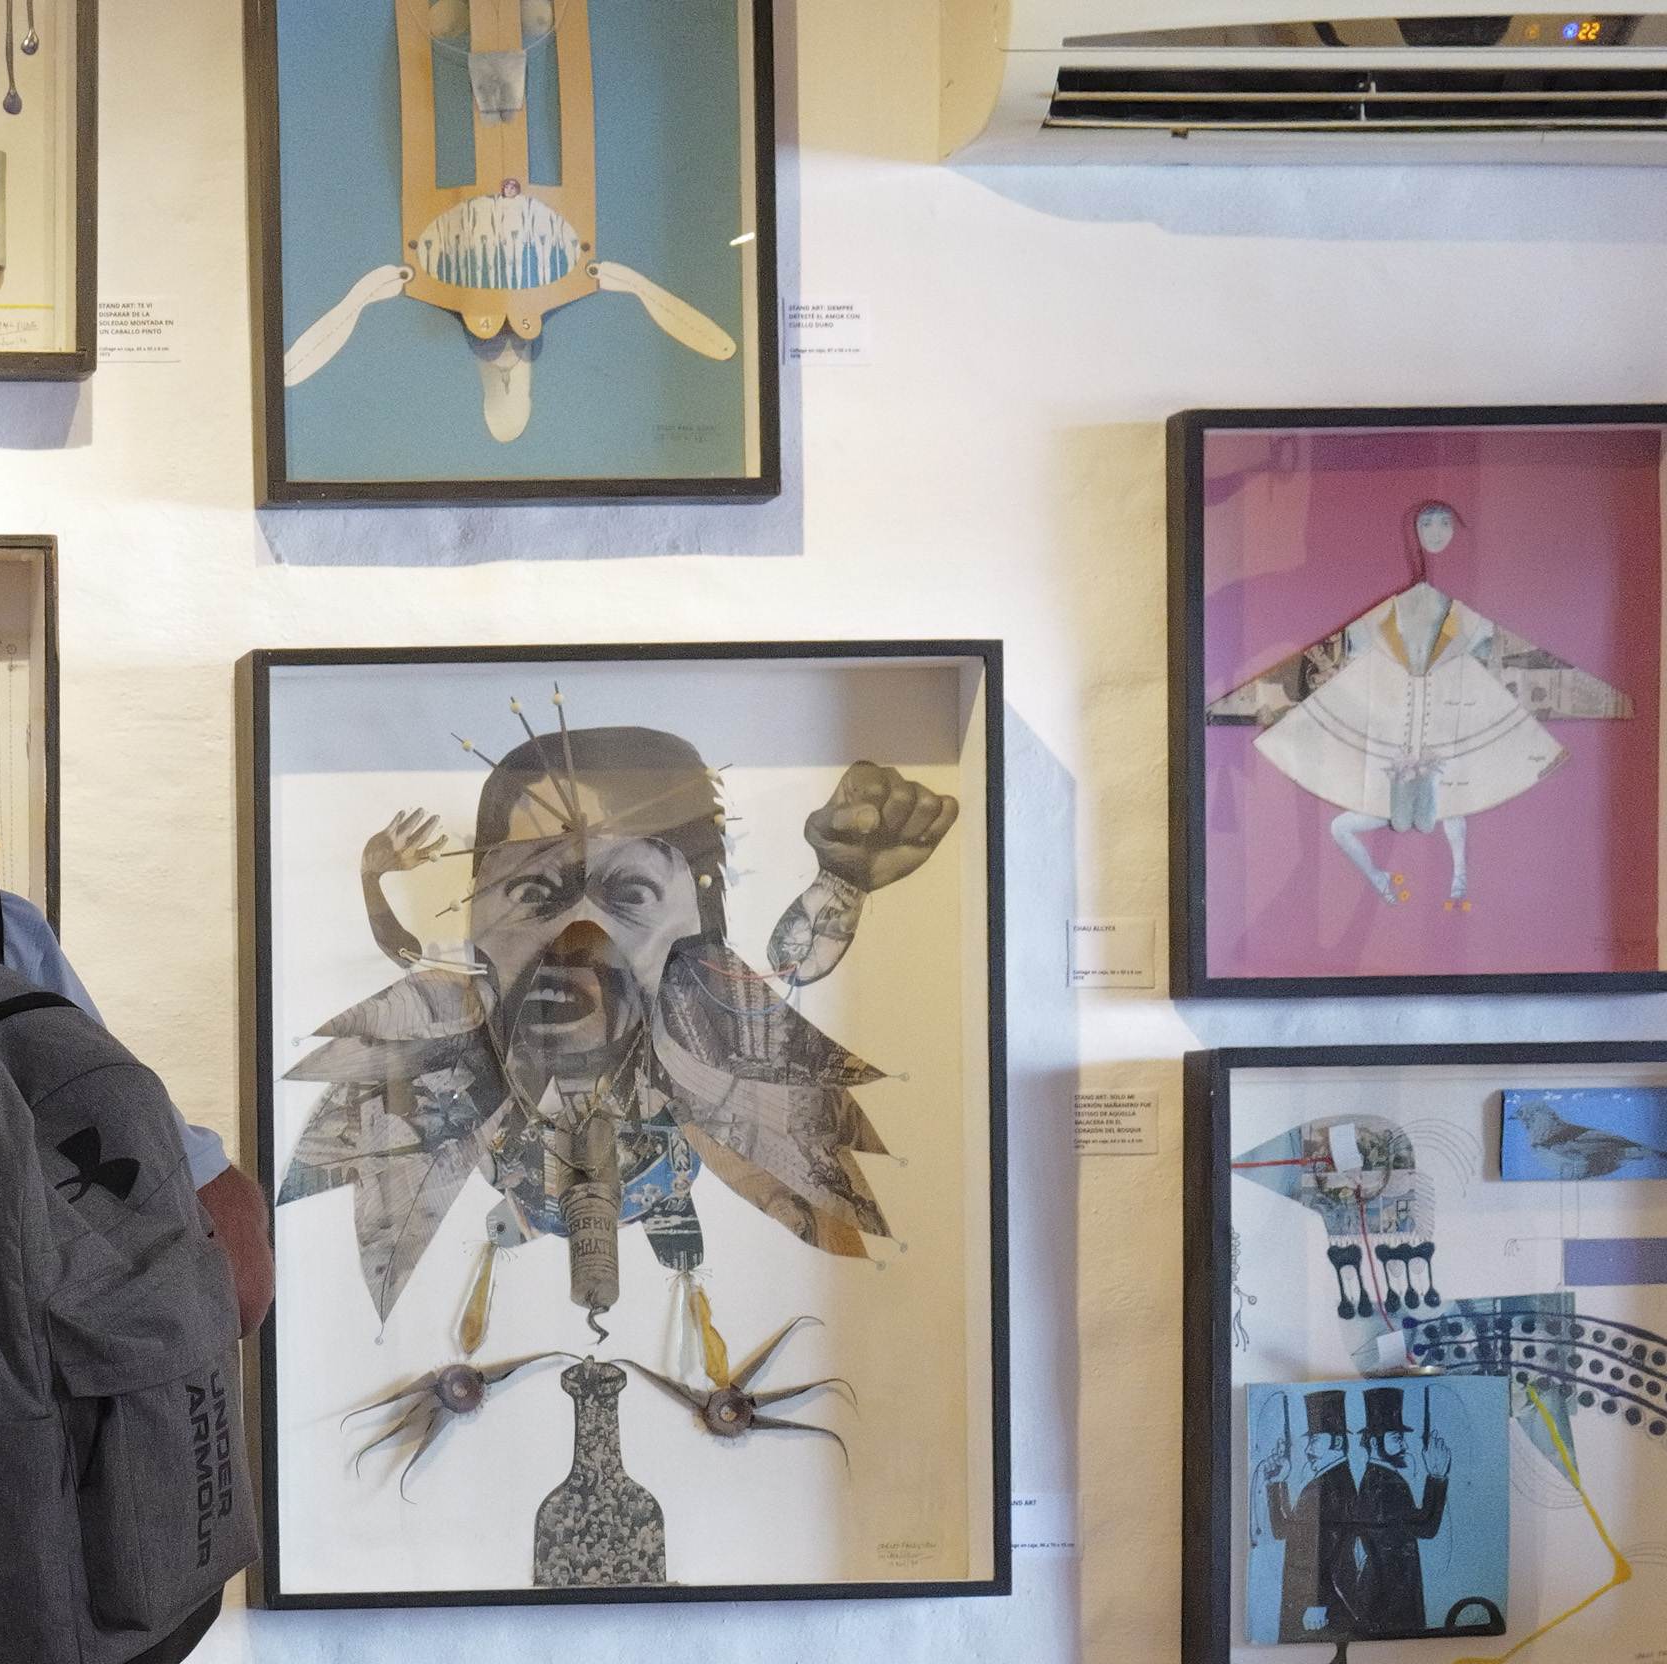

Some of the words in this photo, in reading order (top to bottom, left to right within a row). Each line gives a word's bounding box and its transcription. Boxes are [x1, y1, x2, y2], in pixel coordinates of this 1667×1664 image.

[1578, 22, 1601, 40] 22
[481, 319, 491, 330] 4
[522, 319, 531, 330] 5
[210, 1369, 232, 1521] UNDER
[185, 1383, 213, 1569] ARMOUR
